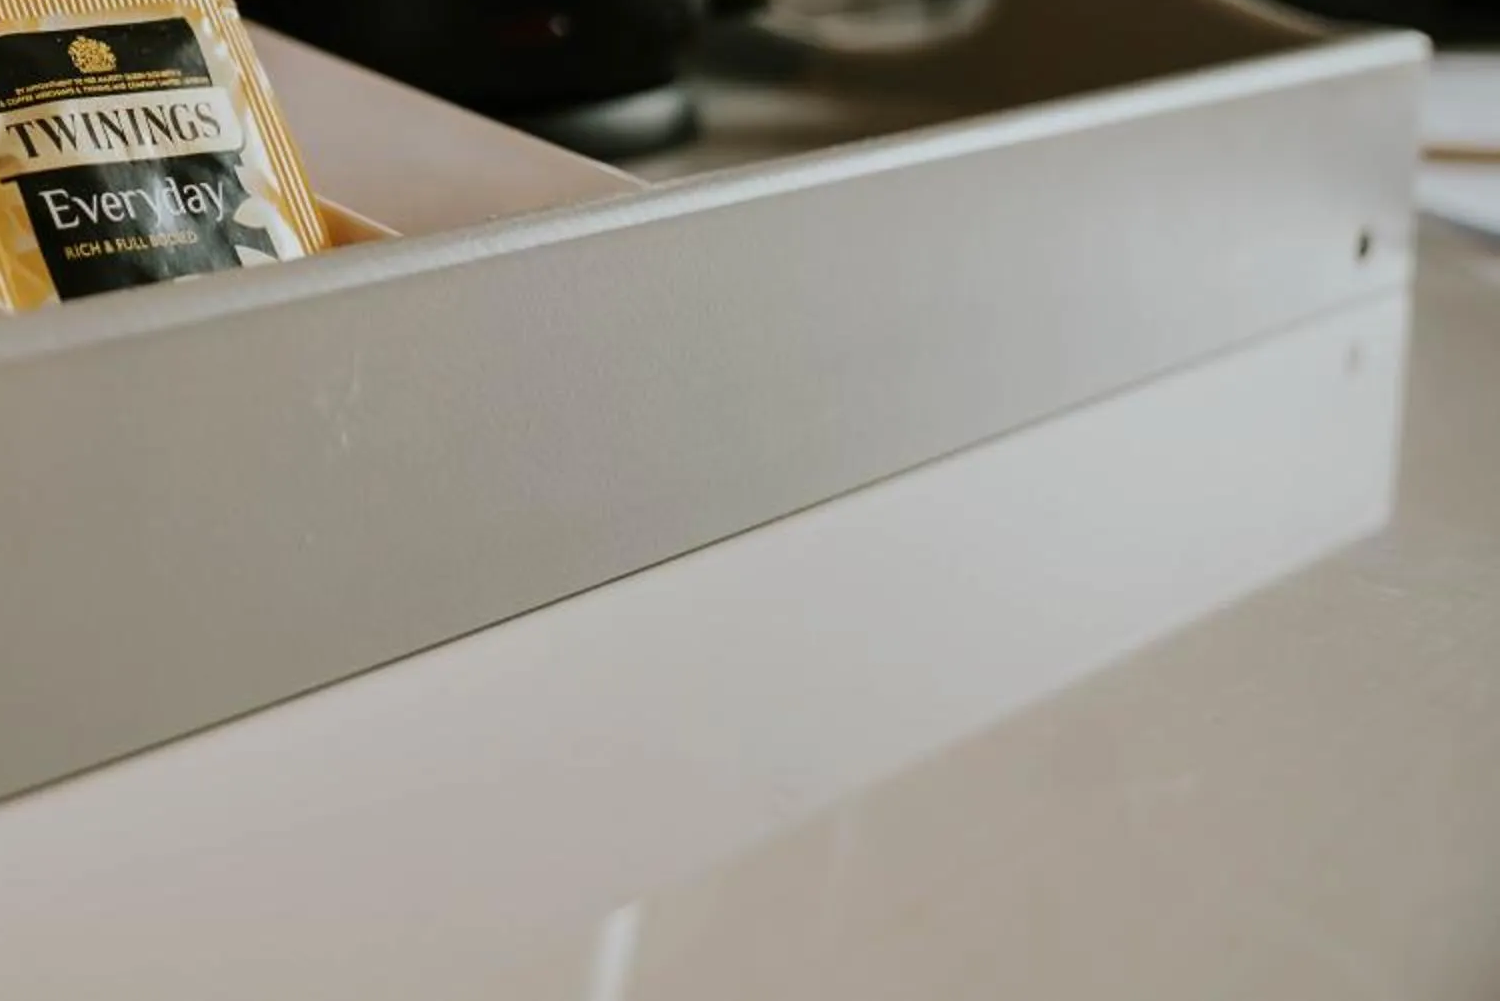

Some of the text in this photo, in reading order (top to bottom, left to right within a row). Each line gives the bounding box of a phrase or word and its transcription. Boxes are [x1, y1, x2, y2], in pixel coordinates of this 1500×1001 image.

[5, 101, 222, 159] TWININGS
[38, 176, 225, 231] Everyday
[64, 240, 102, 260] RICH
[104, 240, 115, 254] &
[116, 236, 149, 254] FULL
